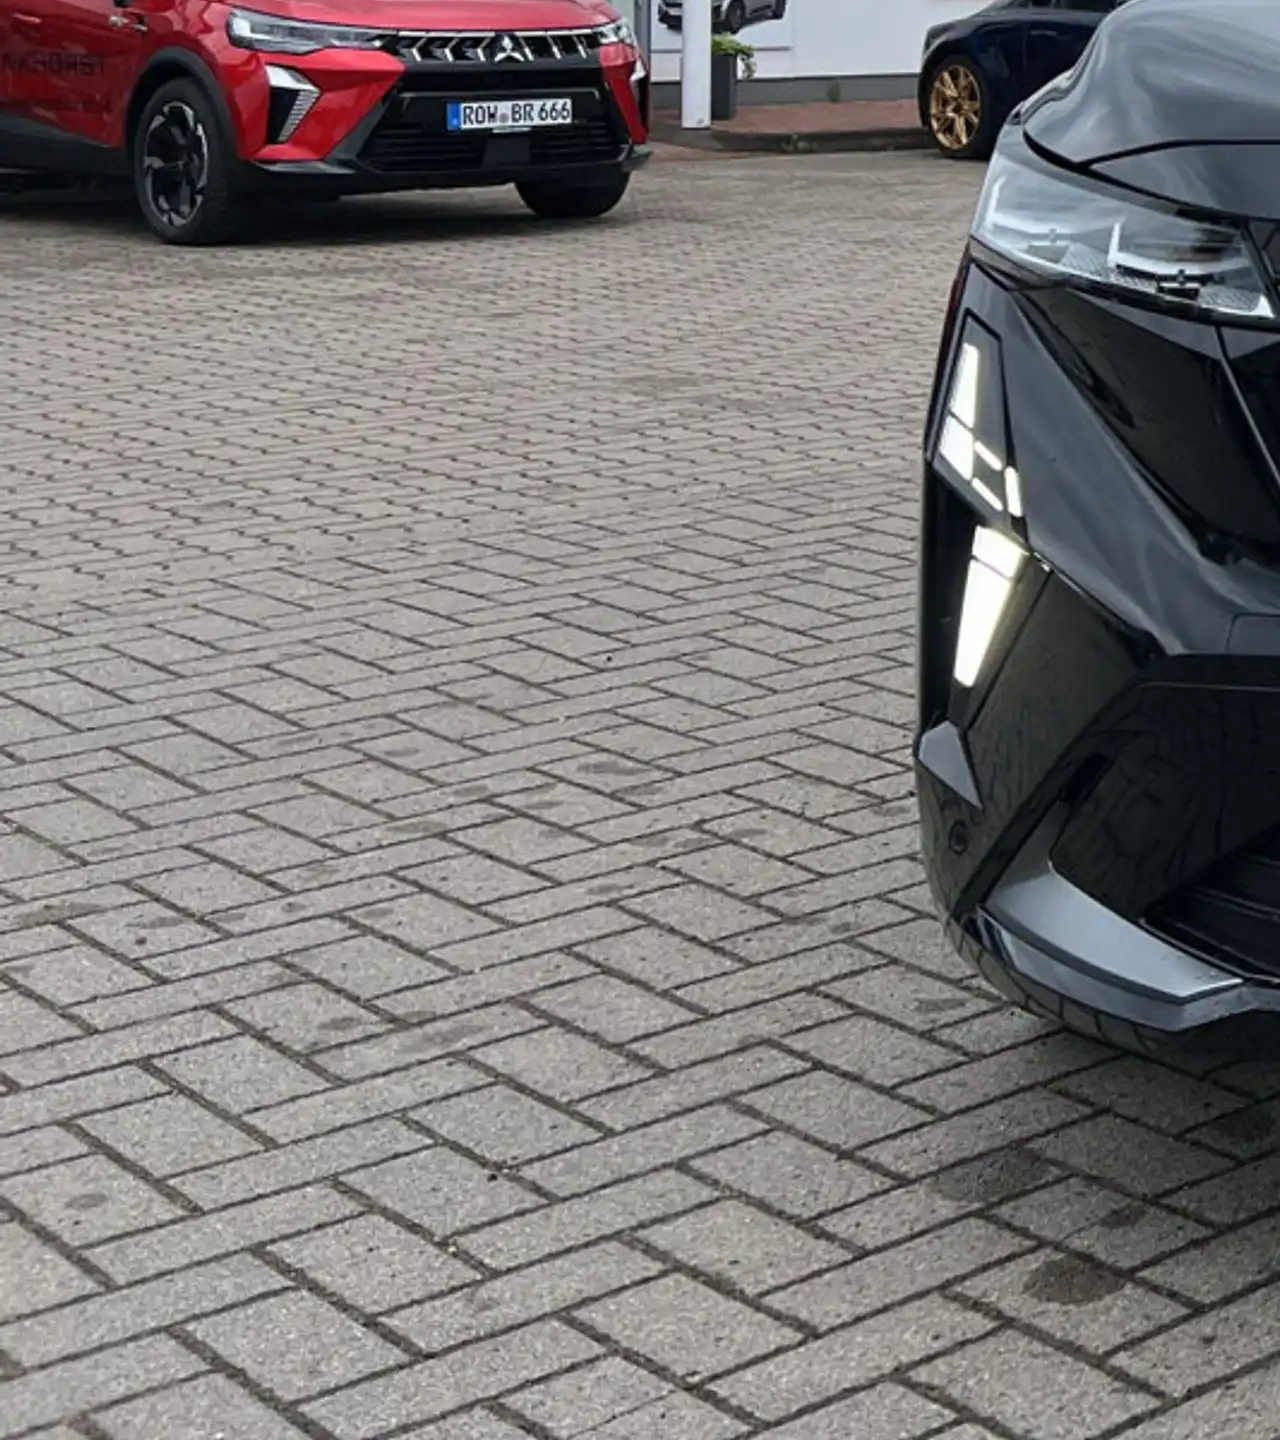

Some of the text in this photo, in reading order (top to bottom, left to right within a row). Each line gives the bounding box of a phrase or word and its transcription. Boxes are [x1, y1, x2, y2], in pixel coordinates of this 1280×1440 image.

[463, 101, 571, 126] ROW BR 666
